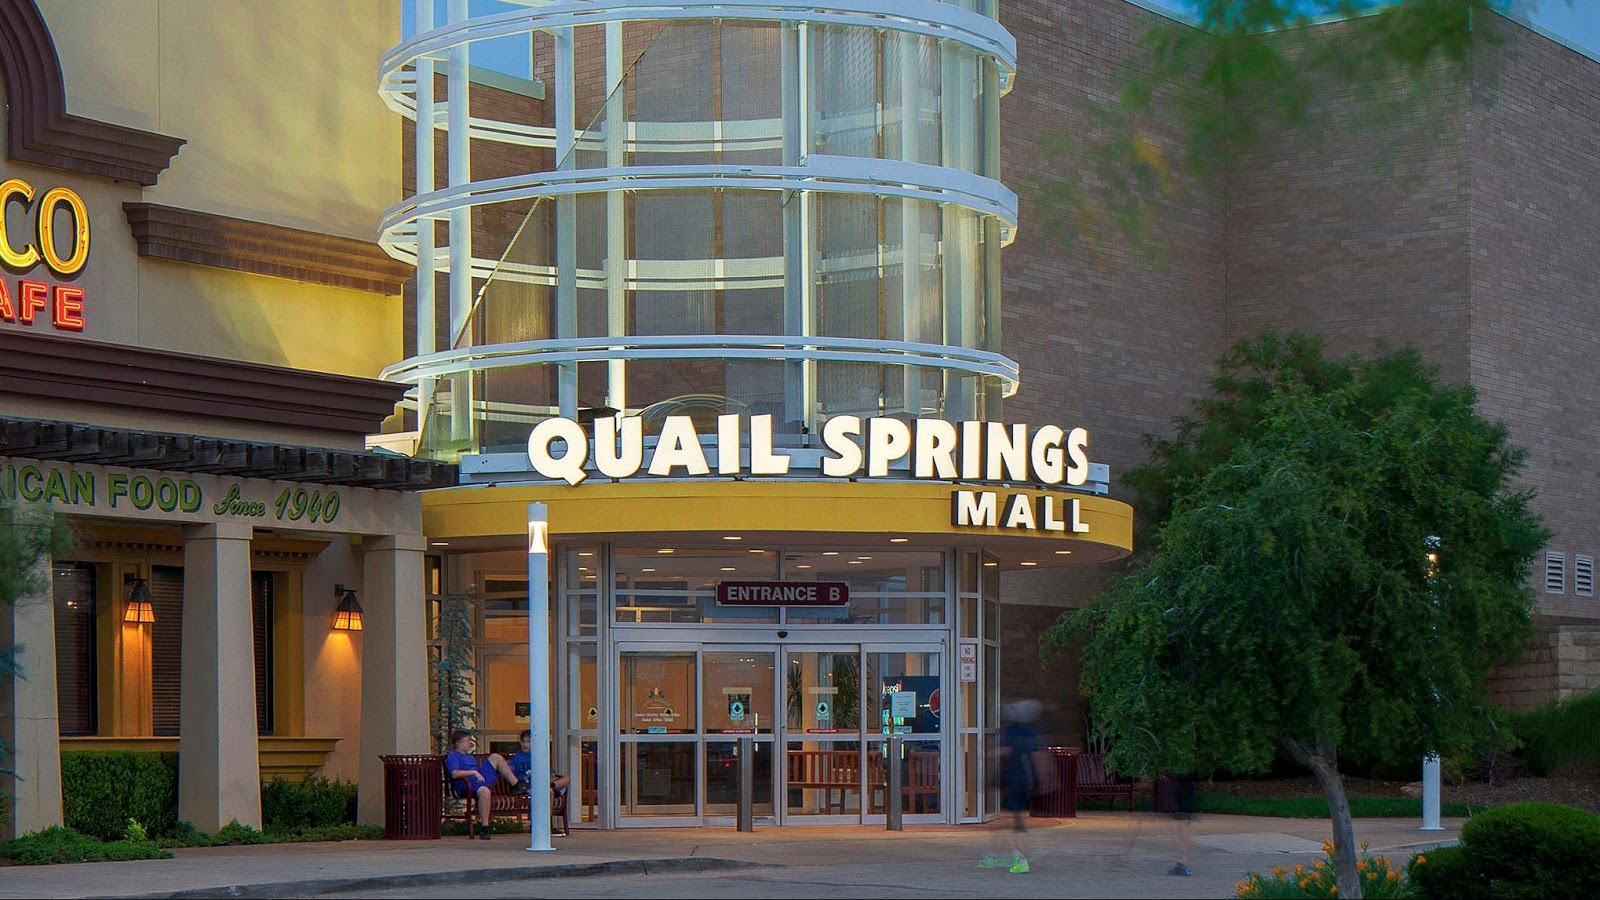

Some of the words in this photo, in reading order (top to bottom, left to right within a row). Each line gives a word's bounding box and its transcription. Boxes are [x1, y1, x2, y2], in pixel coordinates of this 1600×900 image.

[527, 413, 790, 486] QUAIL
[820, 415, 1089, 486] SPRINGS
[0, 463, 95, 507] ICAN
[107, 472, 202, 513] FOOD
[214, 483, 266, 518] Since
[274, 487, 341, 524] 1940
[952, 490, 1090, 534] MALL
[727, 586, 817, 601] ENTRANCE
[829, 588, 841, 601] B
